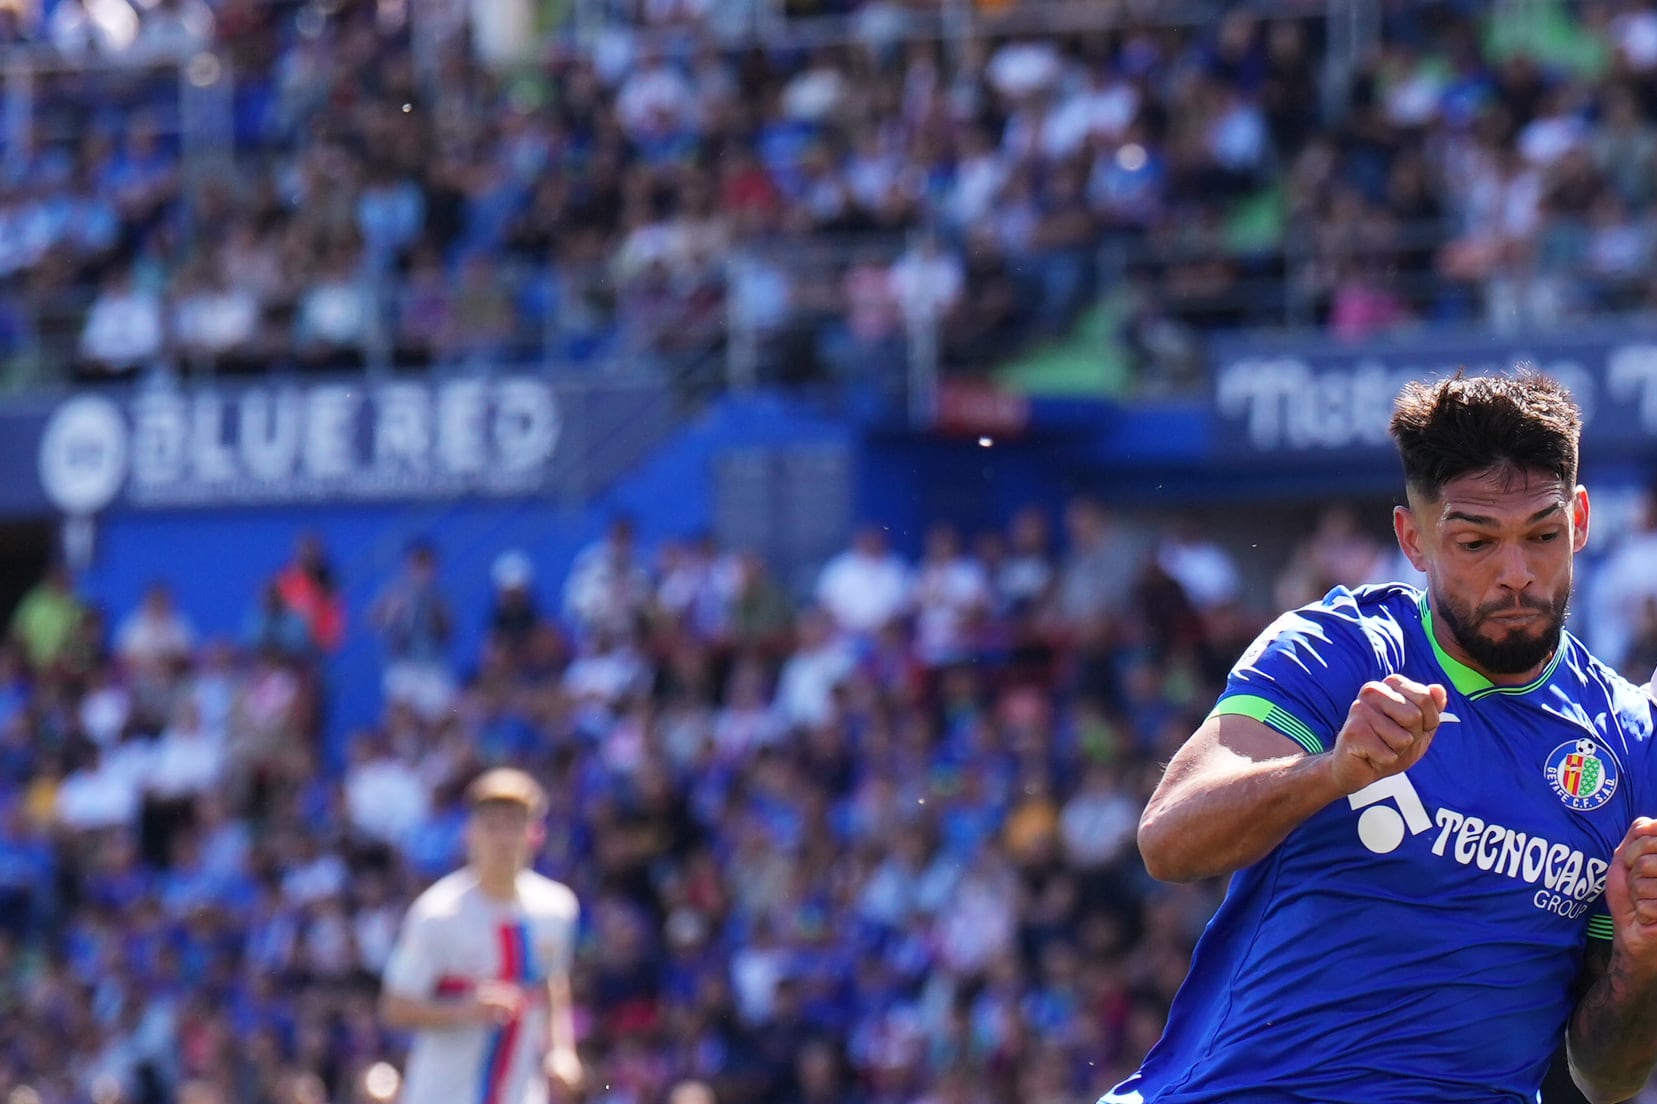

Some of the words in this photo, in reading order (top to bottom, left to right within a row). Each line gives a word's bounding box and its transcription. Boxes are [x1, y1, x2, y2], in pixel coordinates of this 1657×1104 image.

[131, 384, 358, 484] BLUE
[372, 372, 560, 478] RED
[1546, 766, 1570, 803] GETAFE
[1533, 889, 1588, 920] GROUP
